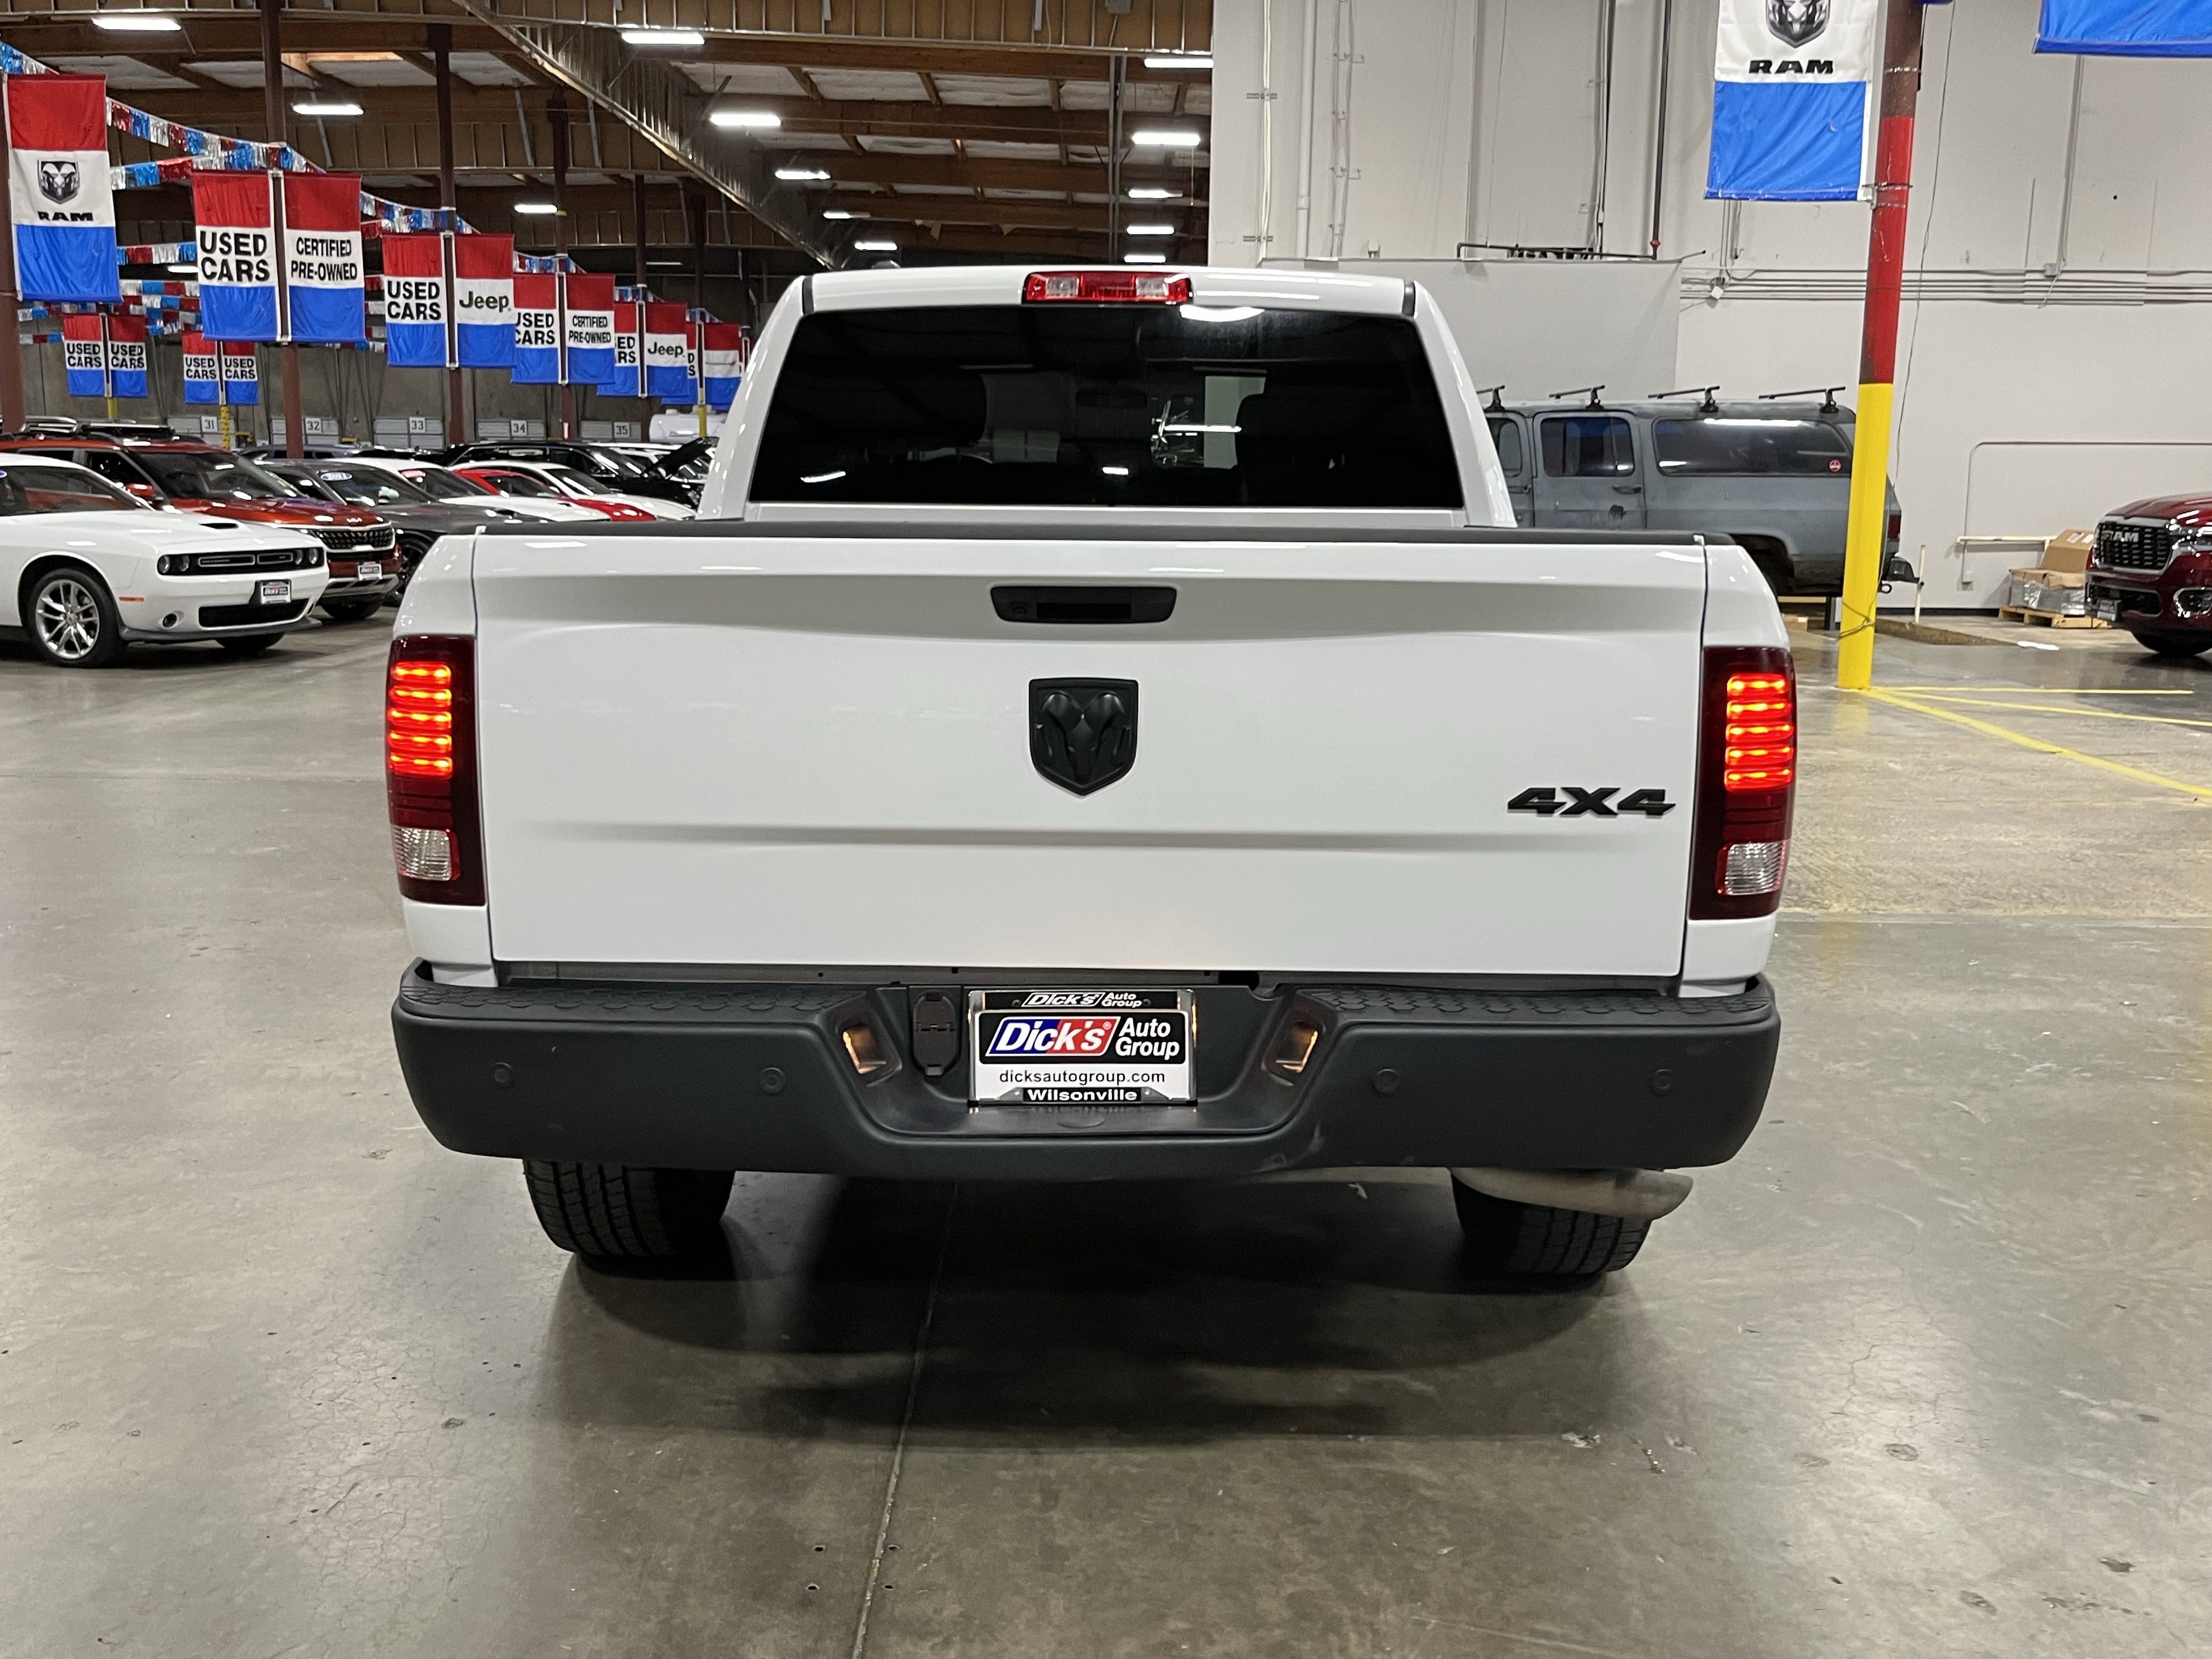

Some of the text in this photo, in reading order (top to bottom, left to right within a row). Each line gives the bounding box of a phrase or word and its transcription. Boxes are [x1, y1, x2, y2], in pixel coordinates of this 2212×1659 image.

[1748, 59, 1833, 74] RAM
[37, 211, 93, 222] RAM
[200, 230, 267, 256] USED
[296, 236, 352, 257] CERTIFIED
[201, 257, 270, 282] CARS
[291, 260, 357, 281] PRE-OWNED
[387, 280, 441, 300] USED
[459, 291, 510, 313] Jeep
[387, 301, 442, 320] CARS
[572, 315, 608, 328] CERTIFIED
[568, 330, 611, 344] PRE-OWNED
[615, 336, 635, 349] ED
[66, 343, 101, 356] USED
[111, 343, 144, 356] USED
[647, 342, 684, 358] Jeep
[67, 356, 103, 368] CARS
[111, 357, 145, 369] CARS
[185, 357, 215, 368] USED
[224, 357, 255, 369] USED
[615, 351, 636, 364] RS
[186, 369, 217, 380] CARS
[224, 369, 256, 380] CARS
[205, 419, 215, 430] 31
[307, 420, 320, 431] 32
[410, 420, 424, 431] 33
[512, 423, 526, 433] 34
[615, 425, 628, 435] 35
[1506, 787, 1676, 817] 4X4
[1104, 992, 1137, 1000] Auto
[1101, 999, 1143, 1008] Group
[1119, 1017, 1171, 1037] Auto
[1115, 1036, 1180, 1060] Group
[999, 1070, 1165, 1086] dicksautogroup.com
[1027, 1089, 1138, 1102] Wilsonville
